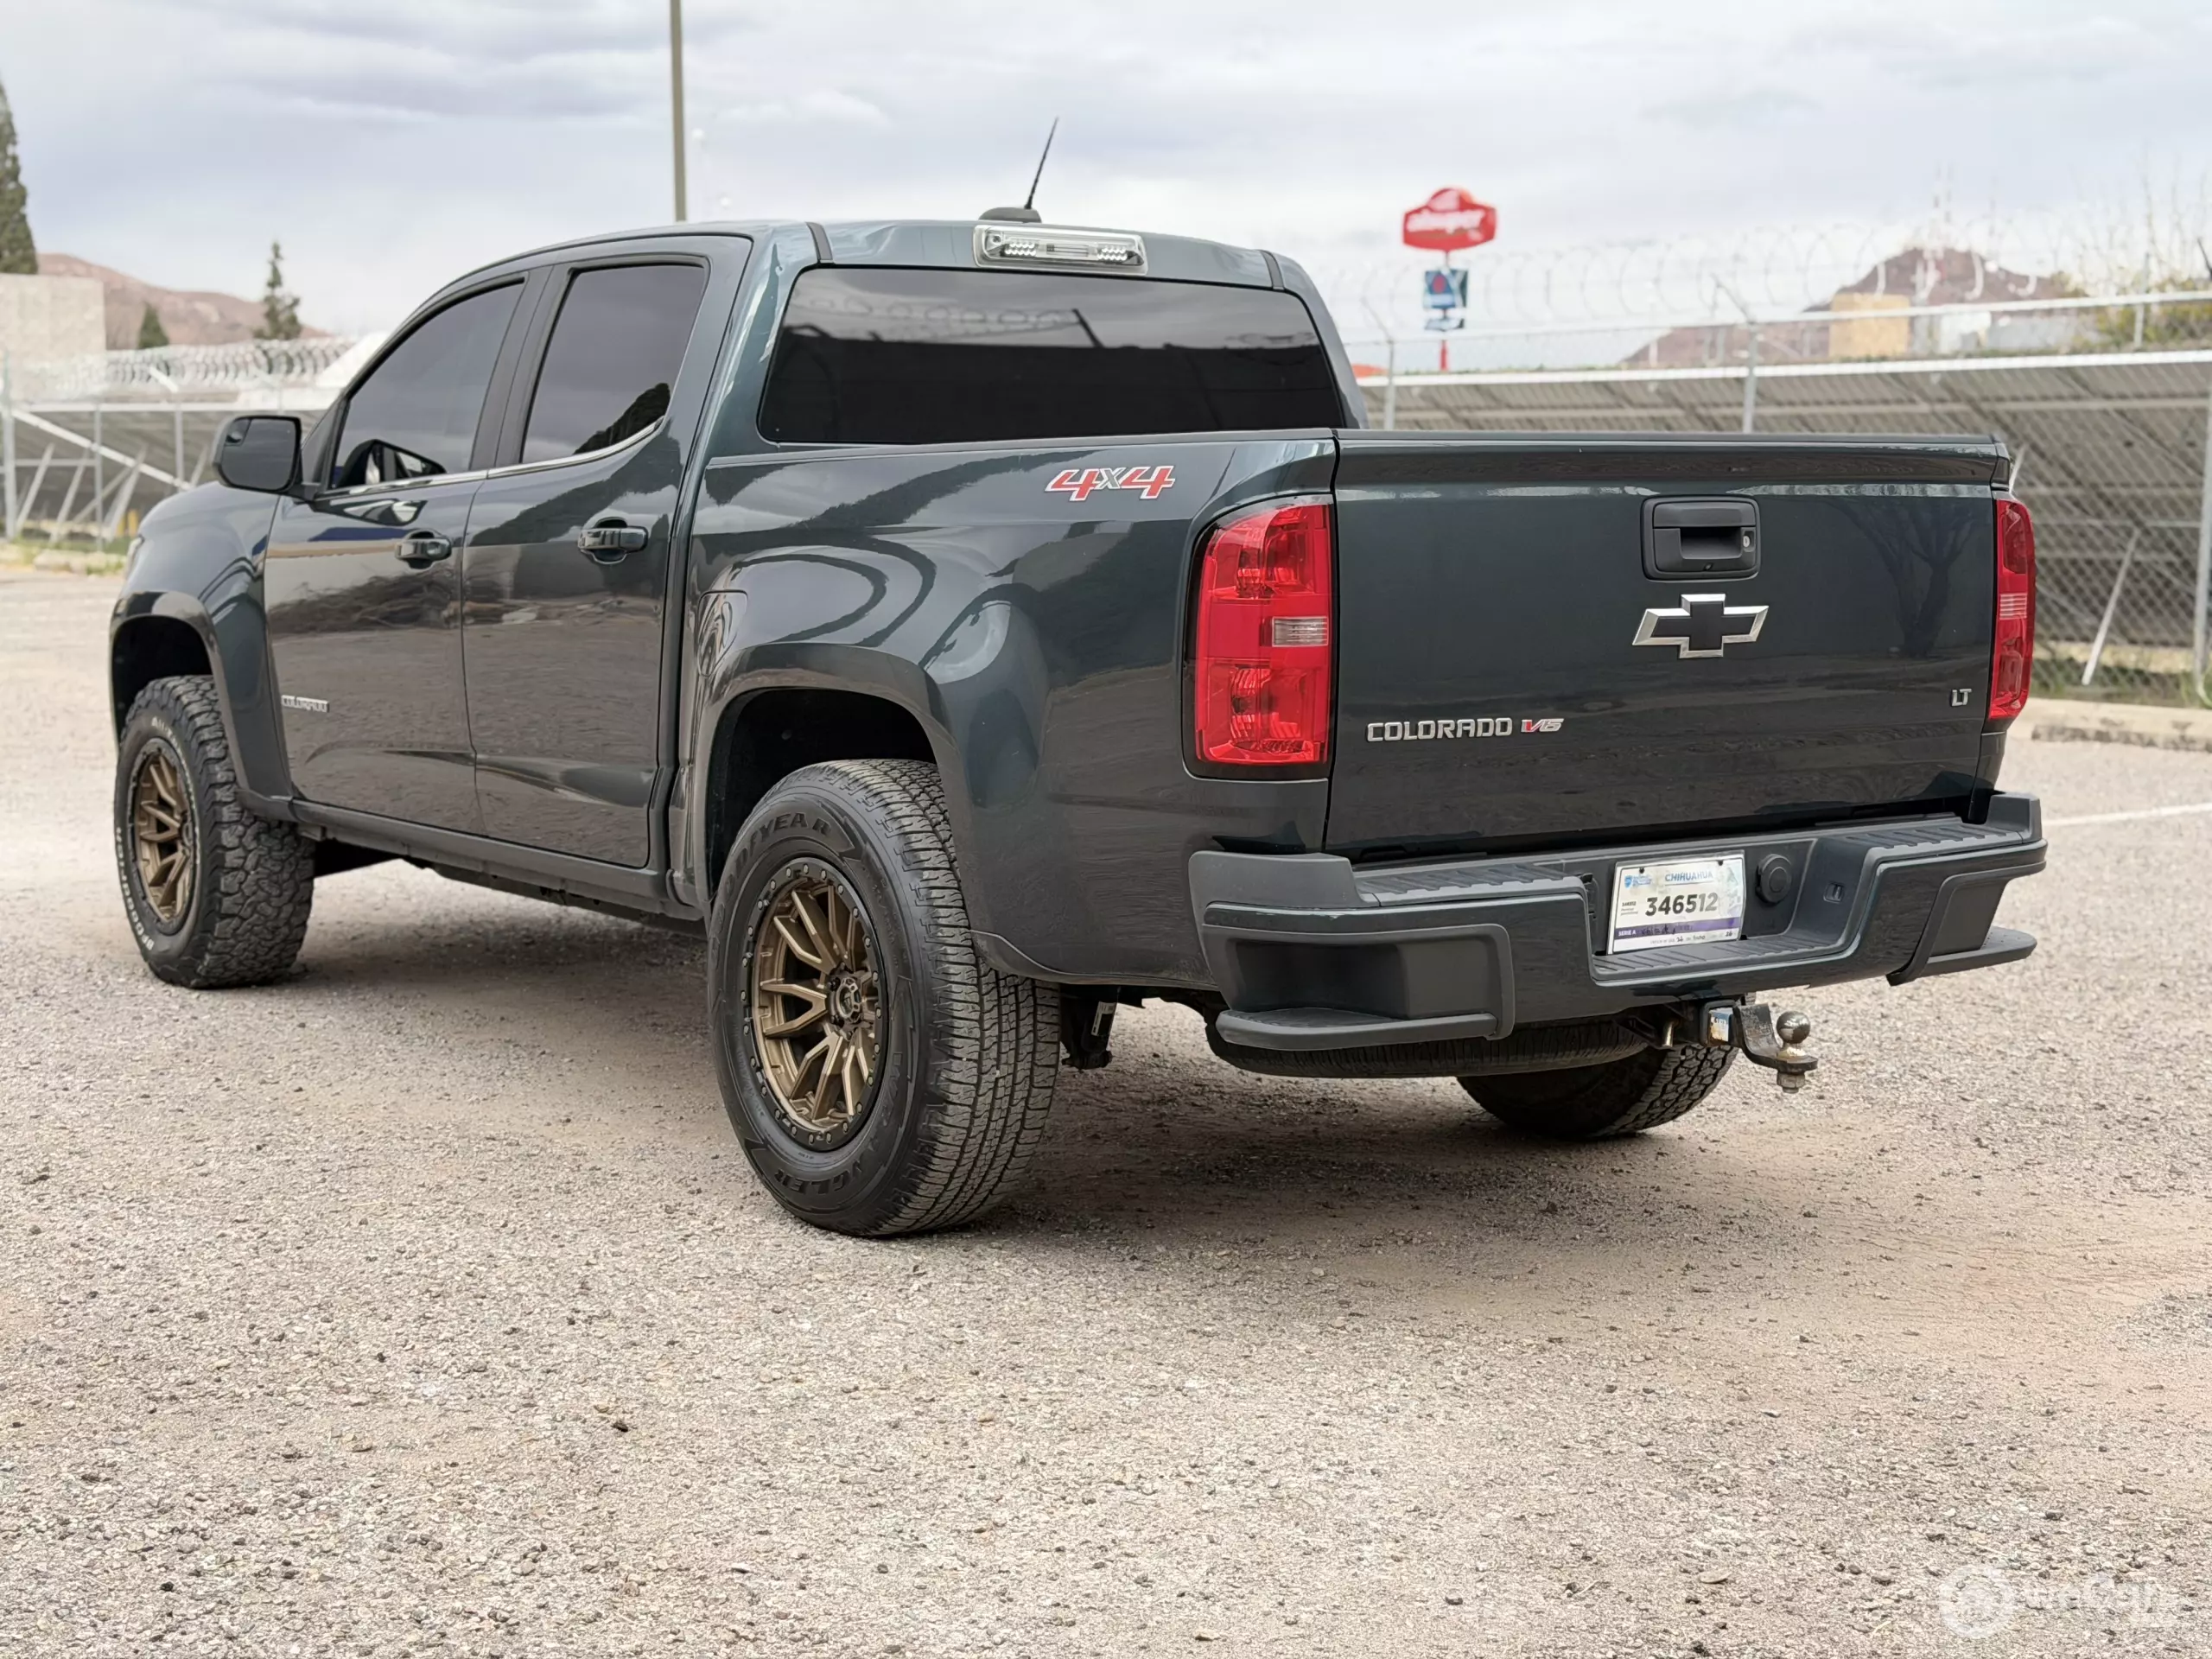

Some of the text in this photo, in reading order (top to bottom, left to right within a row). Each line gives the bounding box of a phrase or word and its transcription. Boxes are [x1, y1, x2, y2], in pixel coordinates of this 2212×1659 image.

[1951, 688, 1973, 707] LT
[1367, 717, 1513, 742] COLORADO
[1664, 871, 1714, 883] CHIHUAHUA
[1644, 892, 1719, 917] 346512
